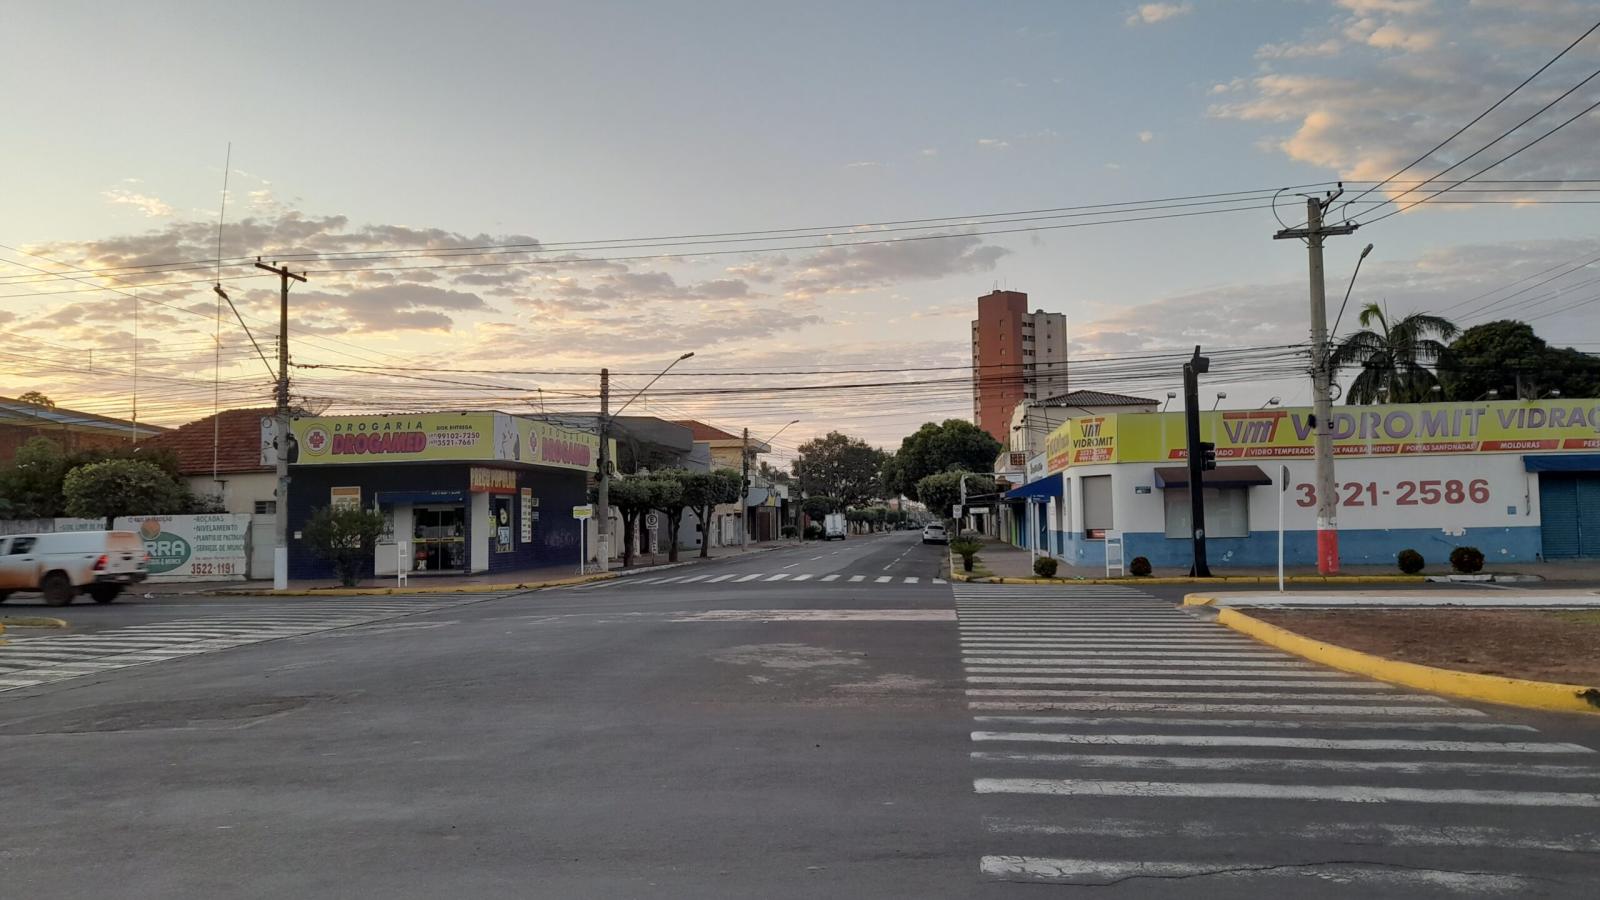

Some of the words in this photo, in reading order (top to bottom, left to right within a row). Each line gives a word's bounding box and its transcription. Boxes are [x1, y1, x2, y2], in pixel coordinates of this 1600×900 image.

[335, 421, 423, 432] DROGARIA
[1291, 408, 1486, 441] VDROMIT
[331, 431, 427, 455] DROGAMED
[1073, 437, 1114, 449] VIDROMIT
[1500, 441, 1540, 449] MOLDURAS
[1251, 448, 1273, 456] VIDRO
[1274, 447, 1316, 455] TEMPERADO
[196, 524, 238, 532] NIVELAMENTO
[144, 540, 185, 557] RRA
